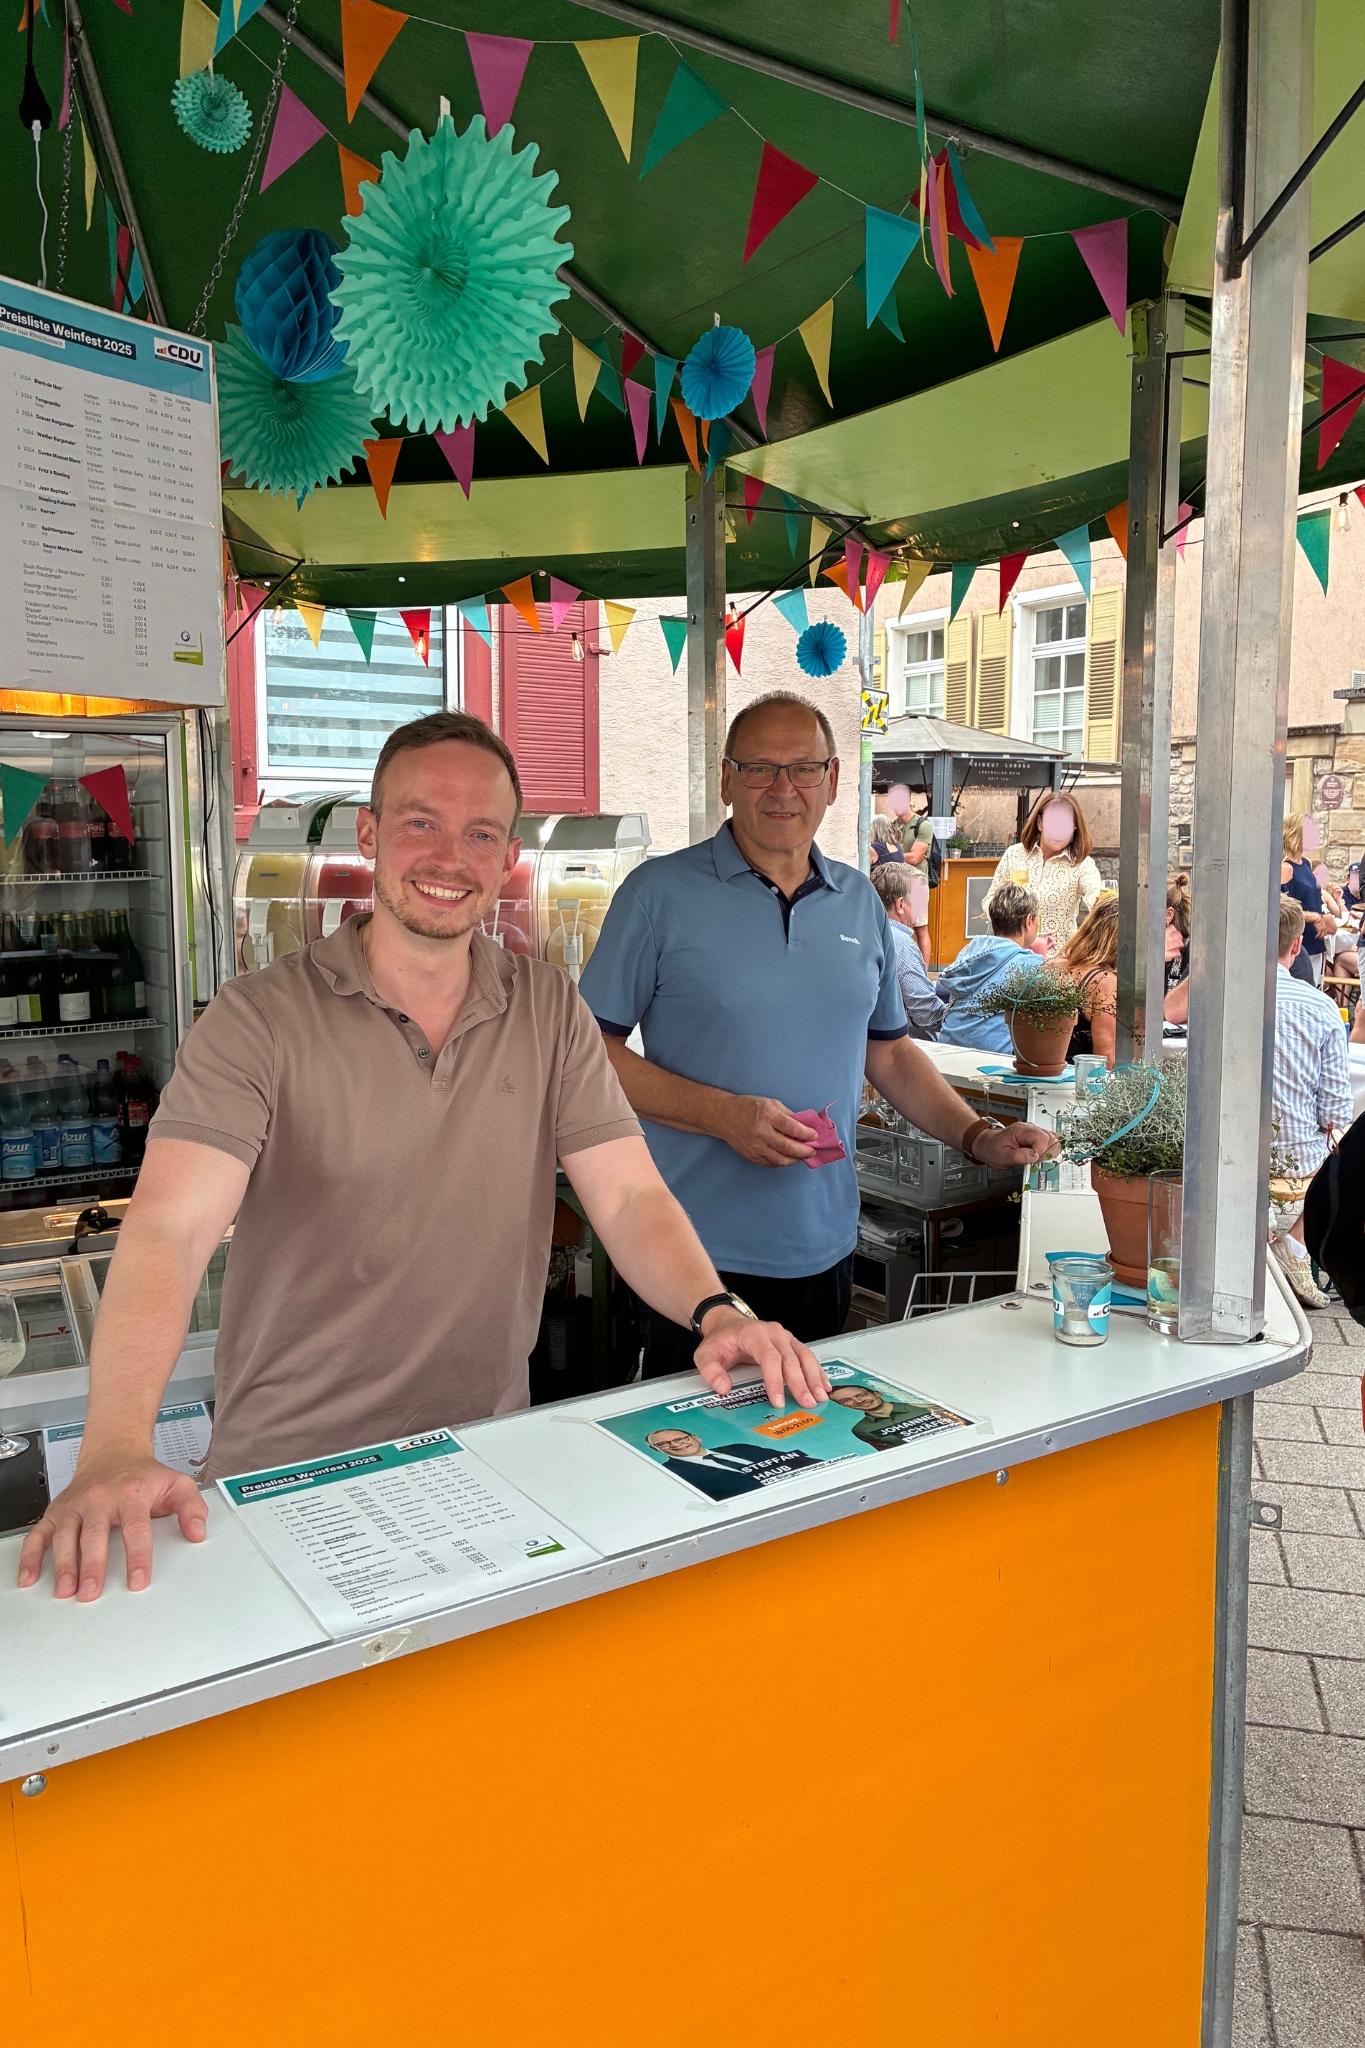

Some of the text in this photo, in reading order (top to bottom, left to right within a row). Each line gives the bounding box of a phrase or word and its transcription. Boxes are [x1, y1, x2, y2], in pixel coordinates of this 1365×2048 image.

[0, 306, 133, 356] Preisliste Weinfest 2025
[167, 344, 201, 364] CDU
[840, 934, 861, 945] Bench.
[62, 1132, 88, 1142] Azur
[2, 1143, 30, 1153] Azur
[674, 1400, 695, 1412] Auf
[696, 1396, 715, 1405] ein
[900, 1418, 955, 1437] SCHÄFER
[408, 1433, 444, 1446] CDU
[741, 1451, 800, 1474] STEFFAN
[241, 1456, 378, 1493] Preisliste Weinfest 2025
[752, 1465, 792, 1481] HAUB
